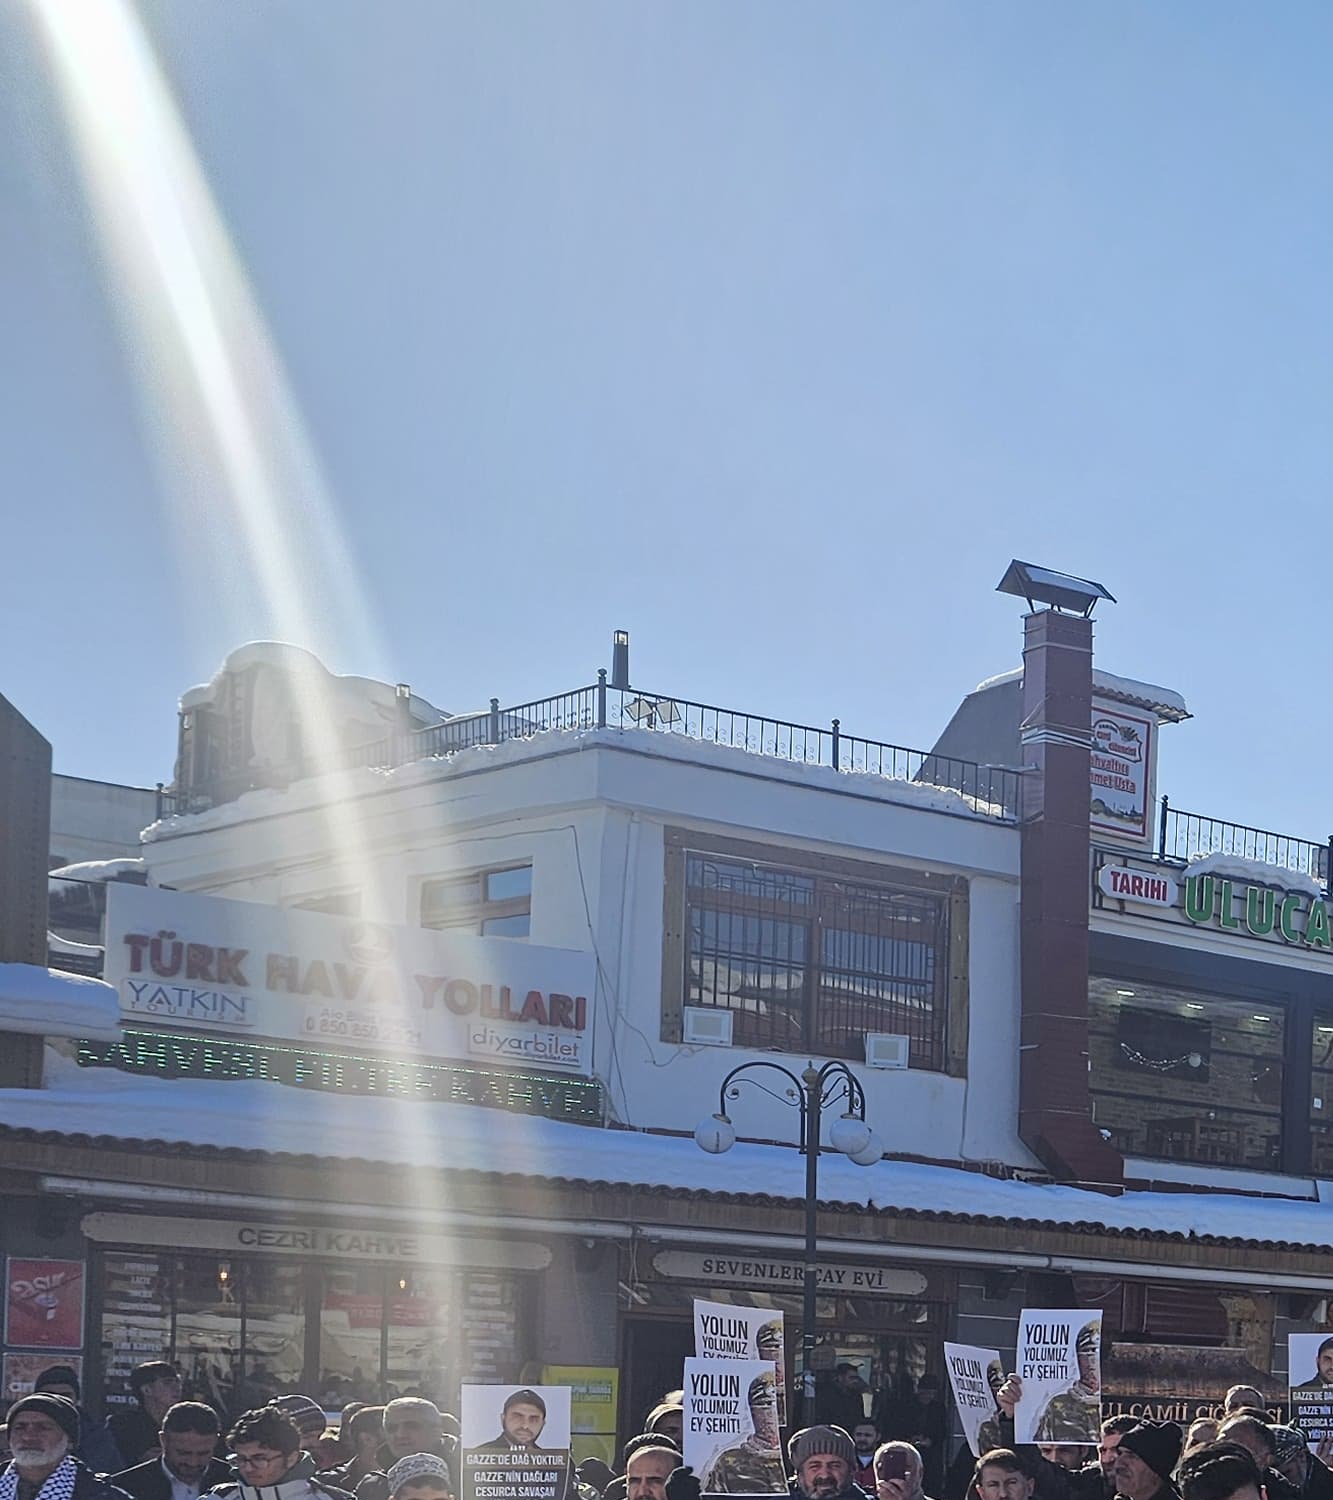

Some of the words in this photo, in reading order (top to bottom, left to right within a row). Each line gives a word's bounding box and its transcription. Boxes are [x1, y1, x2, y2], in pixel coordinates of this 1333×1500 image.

[123, 930, 250, 987] TÜRK
[415, 973, 588, 1031] YOLLARI
[128, 980, 247, 1014] YATKIN
[472, 1026, 580, 1057] diyarbilet
[237, 1227, 316, 1250] CEZRİ
[326, 1232, 420, 1257] KAHVE
[702, 1258, 804, 1282] SEVENLER
[852, 1269, 885, 1288] EVİ
[701, 1313, 748, 1341] YOLUN
[1025, 1323, 1070, 1345] YOLUN
[702, 1335, 748, 1355] YOLUMUZ
[1023, 1346, 1068, 1362] YOLUMUZ
[950, 1356, 982, 1380] YOLUN
[1022, 1364, 1037, 1379] EY
[1037, 1362, 1068, 1382] ŞEHİT!
[691, 1373, 740, 1398] YOLUN
[690, 1398, 739, 1416] YOLUMUZ
[958, 1391, 968, 1406] EY
[690, 1416, 702, 1433] EY
[706, 1415, 741, 1436] ŞEHİT!
[466, 1454, 511, 1466] GAZZE'DE
[512, 1453, 530, 1466] DAĞ
[531, 1454, 566, 1466] YOKTUR.
[474, 1470, 521, 1483] GAZZE'NİN
[522, 1469, 558, 1483] DAĞLARI
[475, 1486, 517, 1497] CESURCA
[518, 1486, 556, 1499] SAVAŞAN
